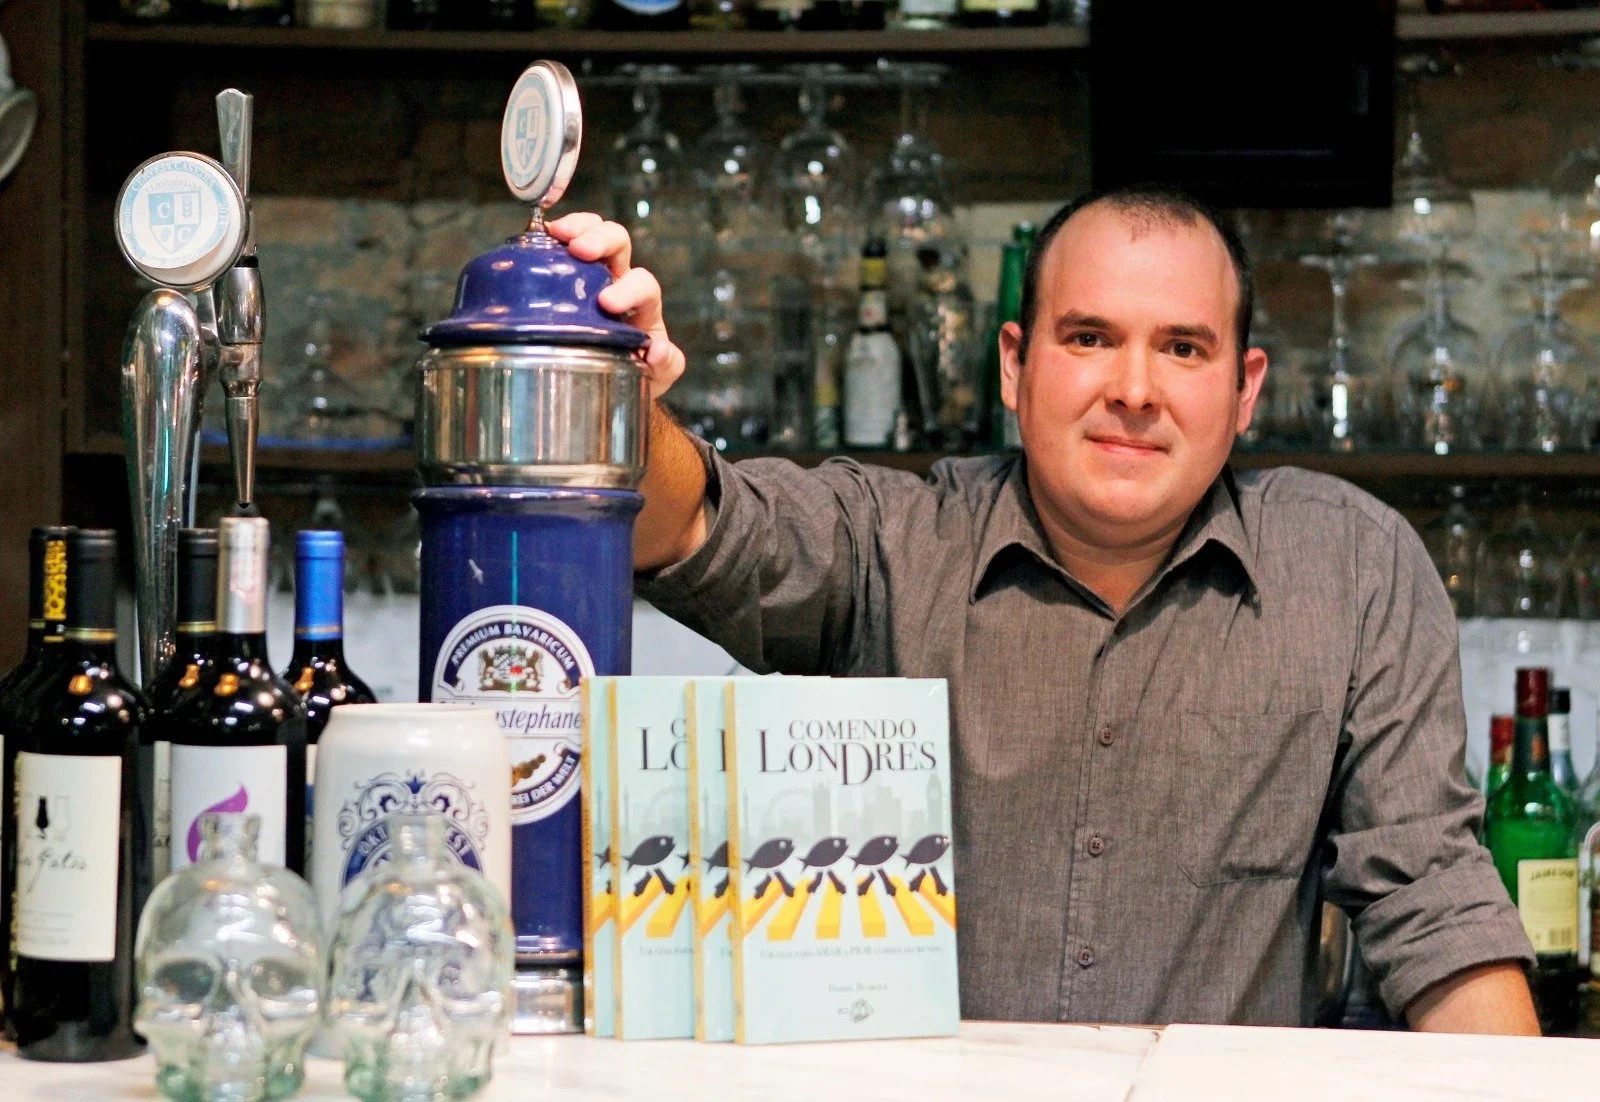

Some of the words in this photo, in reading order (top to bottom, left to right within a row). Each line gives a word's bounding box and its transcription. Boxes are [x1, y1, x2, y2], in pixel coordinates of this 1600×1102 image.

[450, 624, 500, 666] PREMIUM
[503, 623, 575, 670] BAVARICUM
[495, 704, 581, 734] stephane
[788, 719, 916, 740] COMENDO
